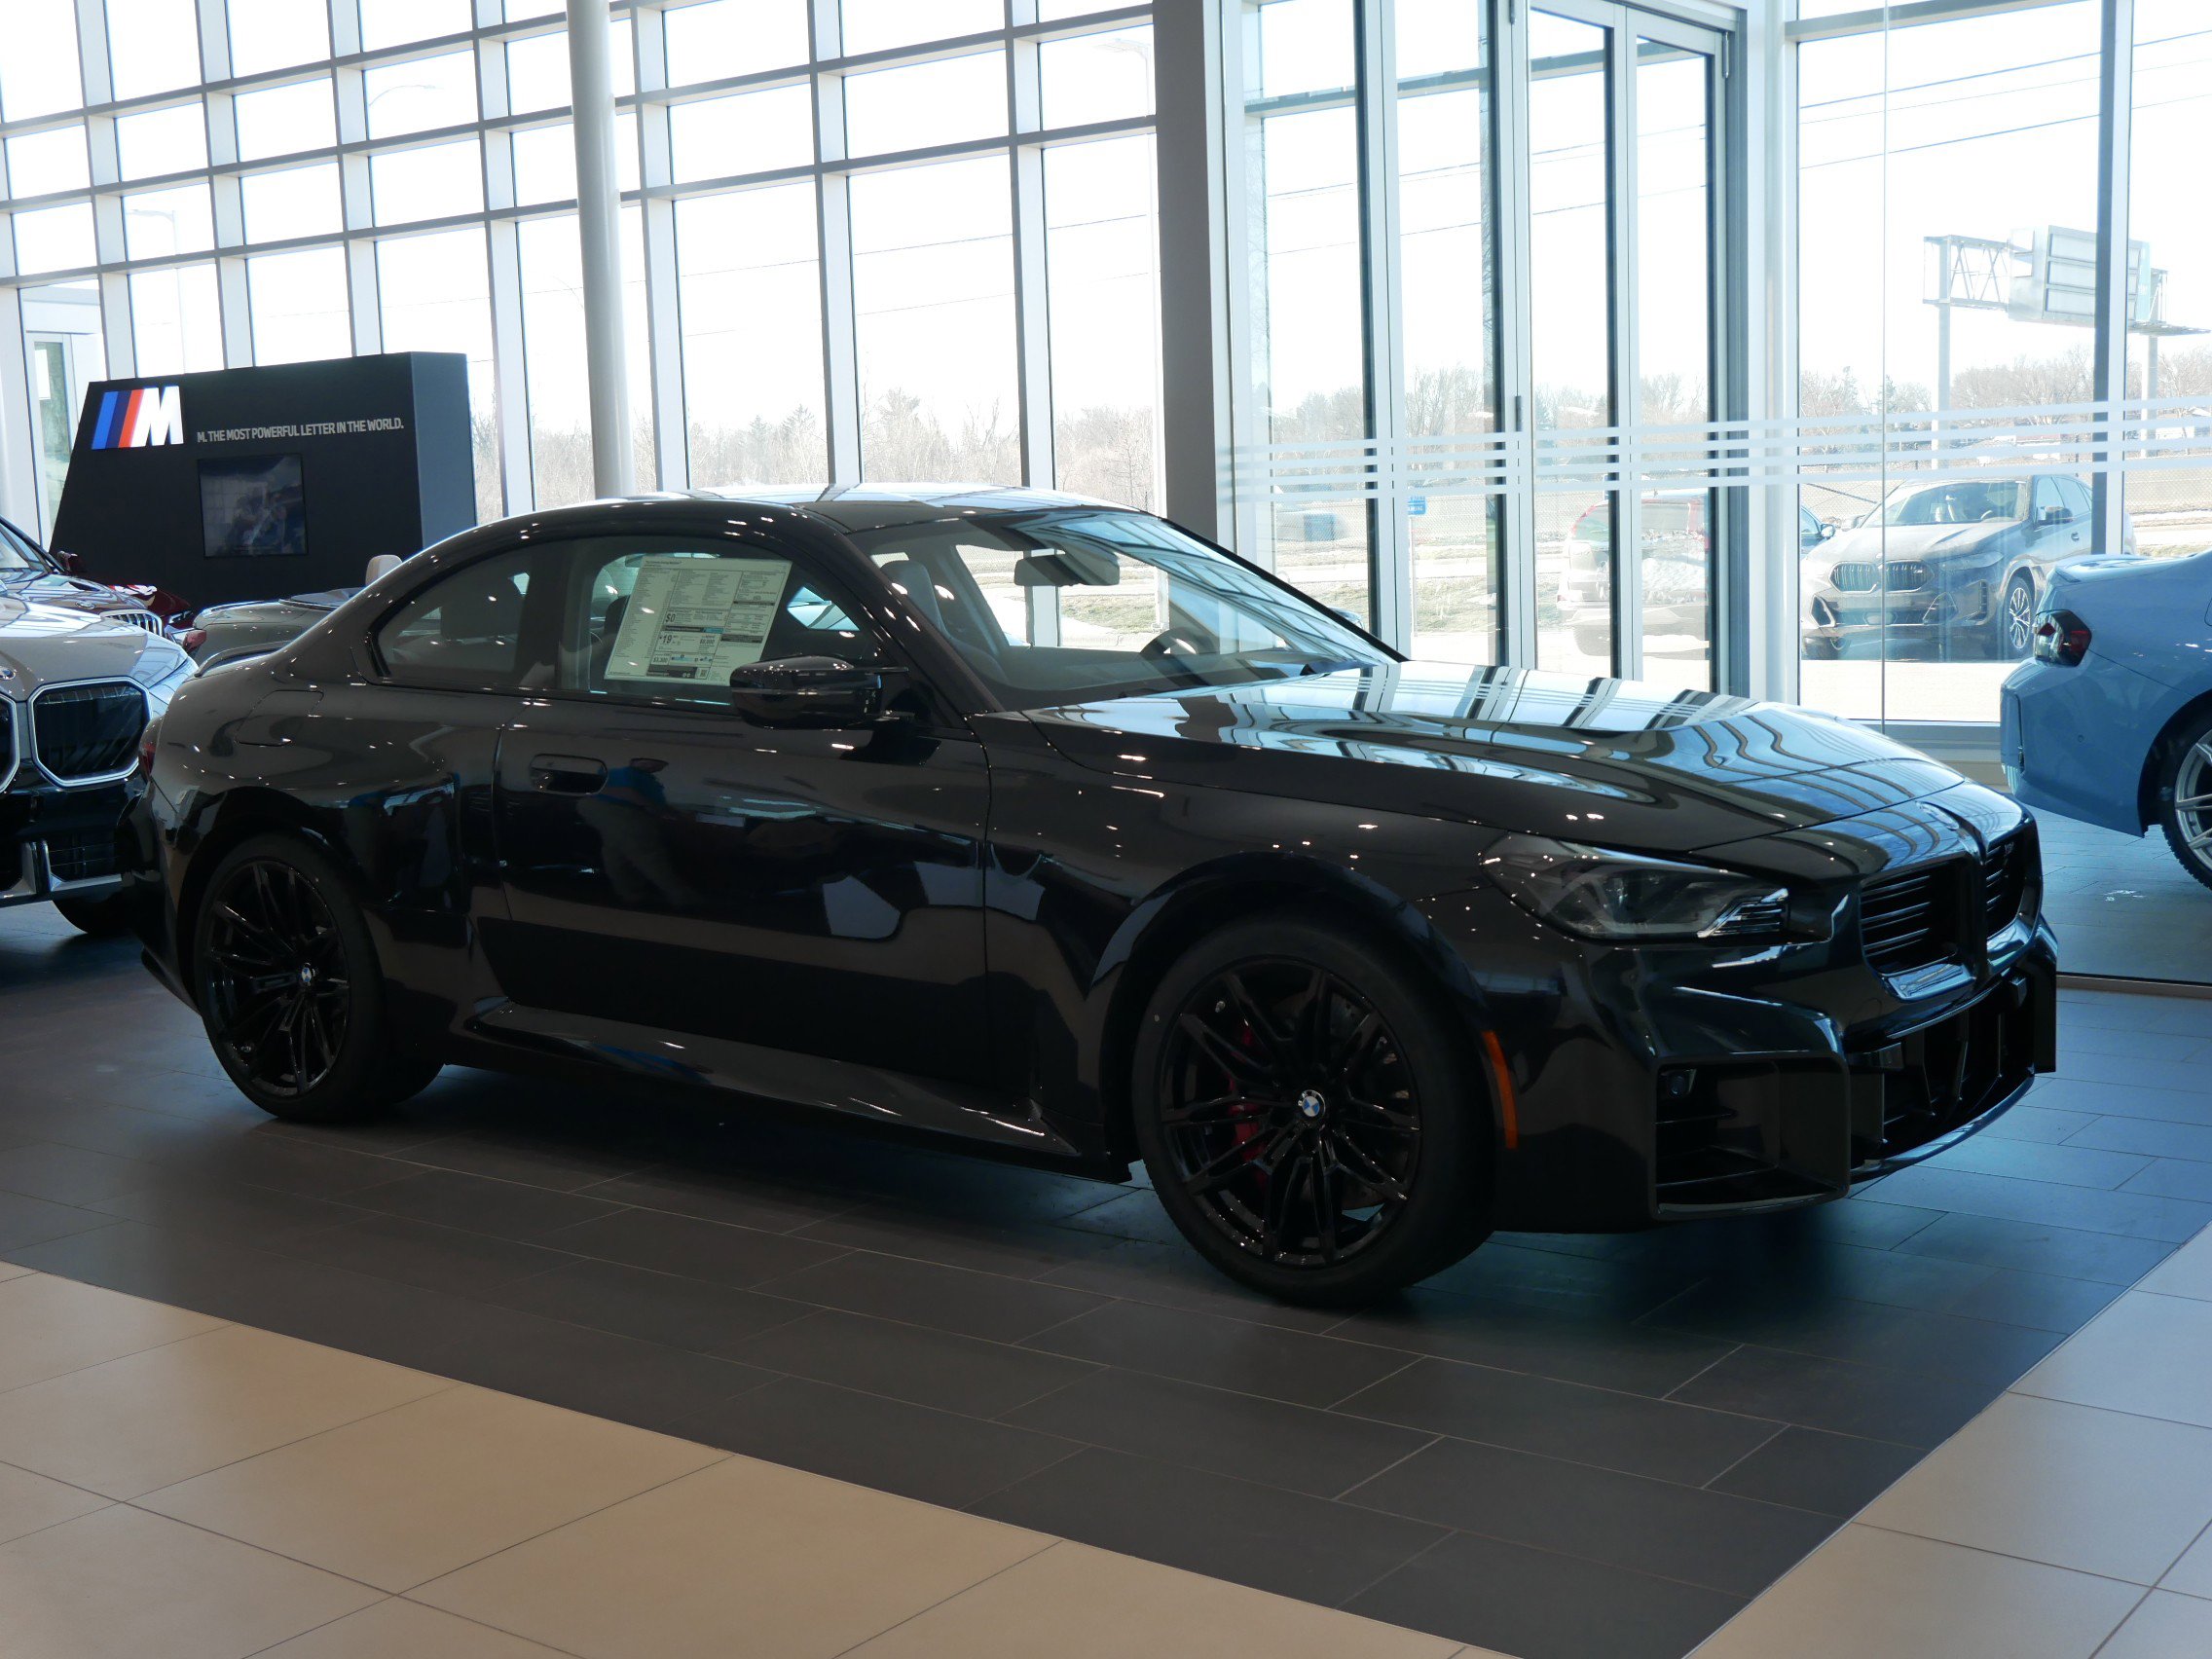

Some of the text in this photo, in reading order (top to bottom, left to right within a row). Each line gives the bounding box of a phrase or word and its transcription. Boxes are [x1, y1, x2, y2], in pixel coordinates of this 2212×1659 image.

[130, 386, 184, 448] M
[197, 418, 405, 443] M. THE MOST POWERFUL LETTER IN THE WORLD.
